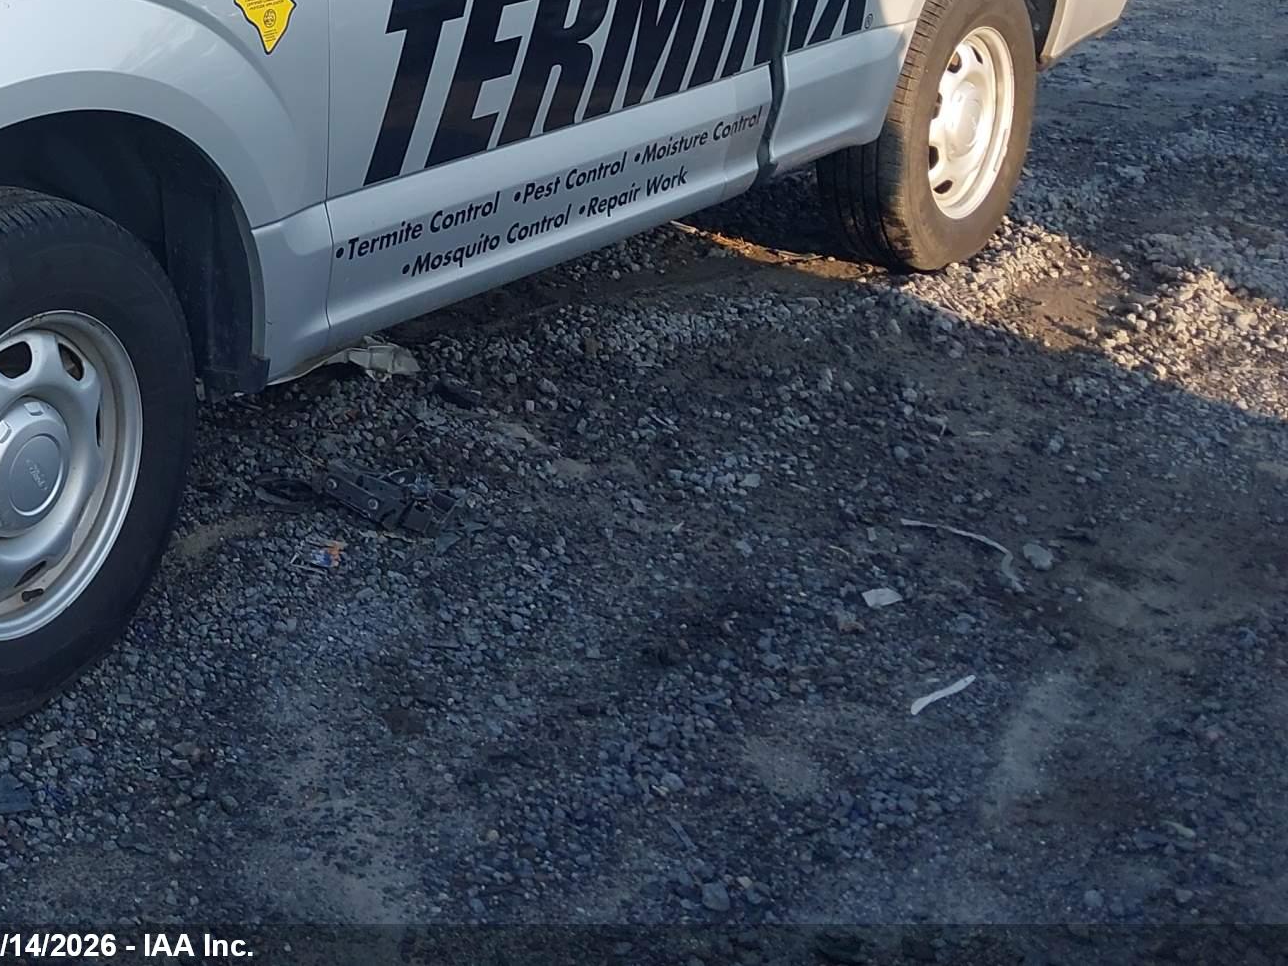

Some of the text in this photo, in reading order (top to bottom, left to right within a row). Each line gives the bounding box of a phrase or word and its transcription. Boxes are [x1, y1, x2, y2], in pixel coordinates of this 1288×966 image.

[713, 105, 763, 141] Control
[566, 152, 627, 190] Control
[646, 165, 688, 196] Work
[430, 191, 500, 233] Control
[507, 204, 572, 245] Control
